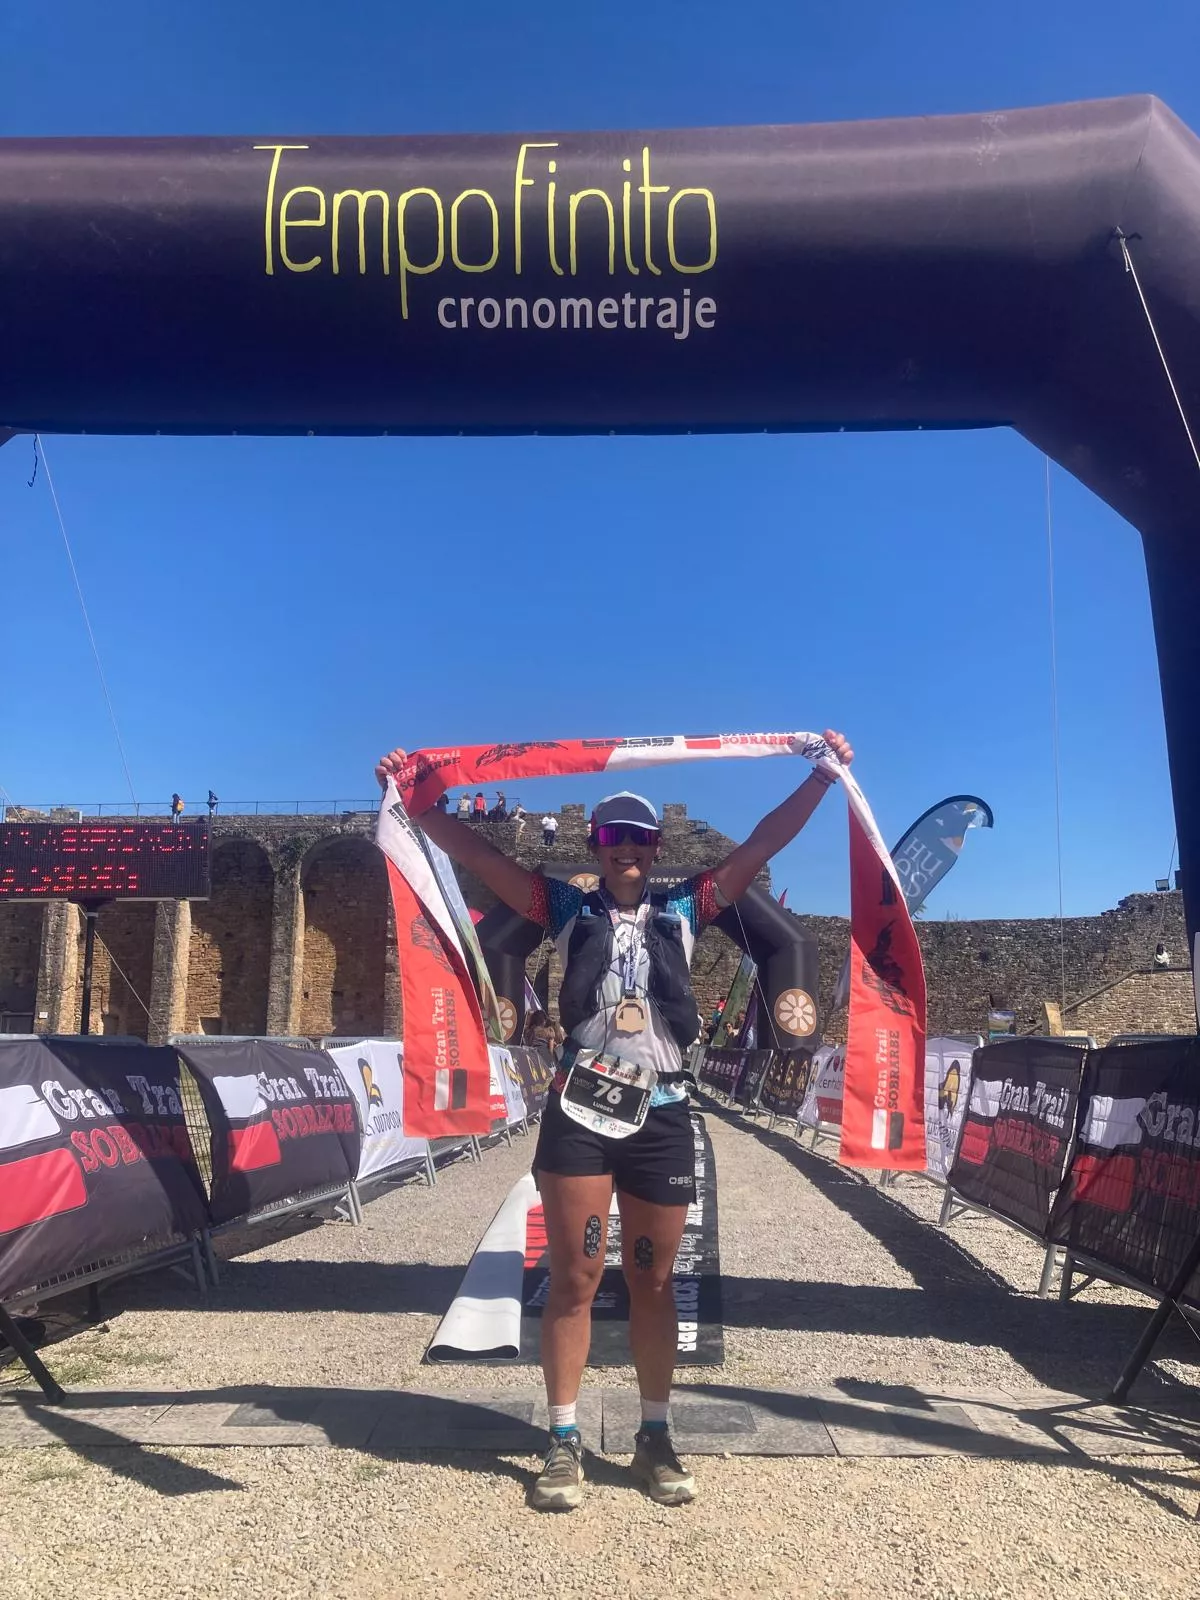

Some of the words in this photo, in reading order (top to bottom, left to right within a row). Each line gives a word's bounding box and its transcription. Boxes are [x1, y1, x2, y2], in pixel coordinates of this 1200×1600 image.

[437, 288, 718, 340] cronometraje
[721, 735, 798, 746] SOBRARBE
[430, 987, 444, 1025] Trail
[446, 988, 460, 1067] SOBRARBE
[875, 1028, 888, 1064] Trail
[434, 1030, 447, 1068] Gran
[257, 1071, 308, 1102] Gran
[303, 1071, 350, 1099] Trail
[873, 1070, 888, 1108] Gran
[887, 1030, 900, 1110] SOBRARBE
[40, 1080, 126, 1121] Gran
[125, 1075, 184, 1116] Tra
[593, 1079, 624, 1105] 76
[1000, 1077, 1030, 1113] Gran
[1028, 1080, 1070, 1129] Trail
